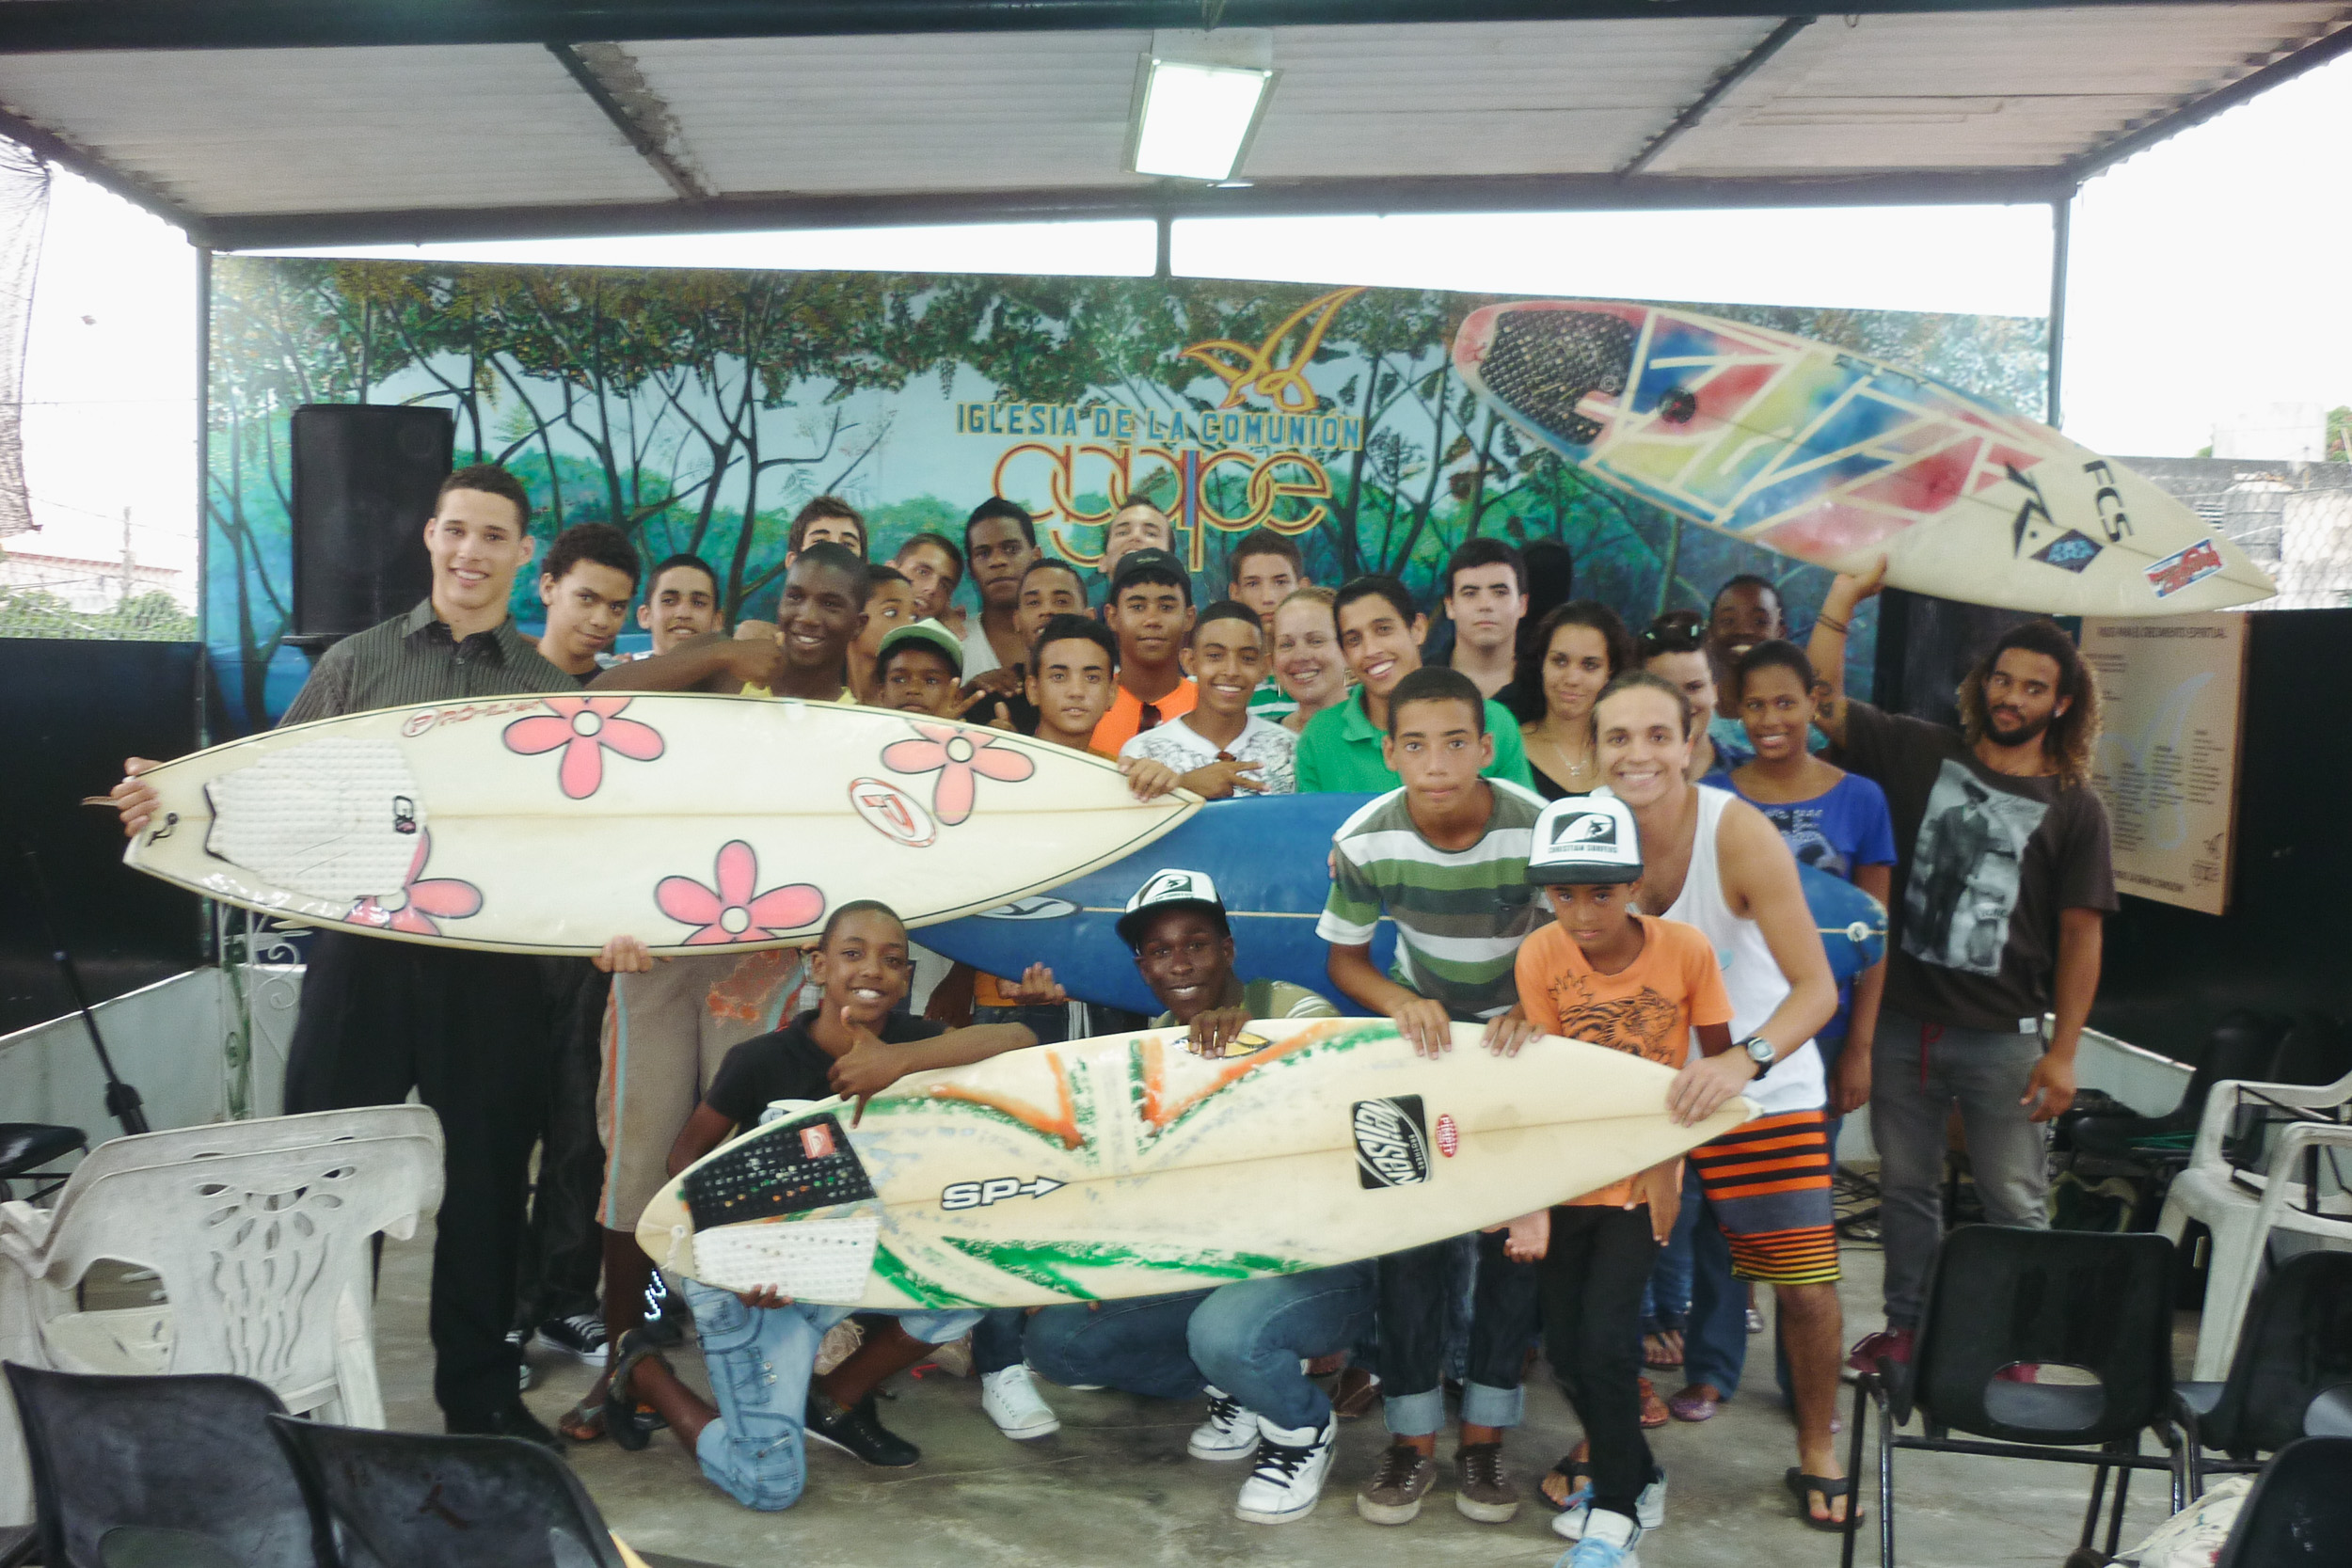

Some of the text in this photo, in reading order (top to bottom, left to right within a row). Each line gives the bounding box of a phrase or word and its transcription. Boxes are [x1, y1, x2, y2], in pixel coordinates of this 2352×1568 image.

[956, 403, 1365, 451] IGLESIA DE LA COMUNIÓN
[2082, 460, 2135, 543] FCS
